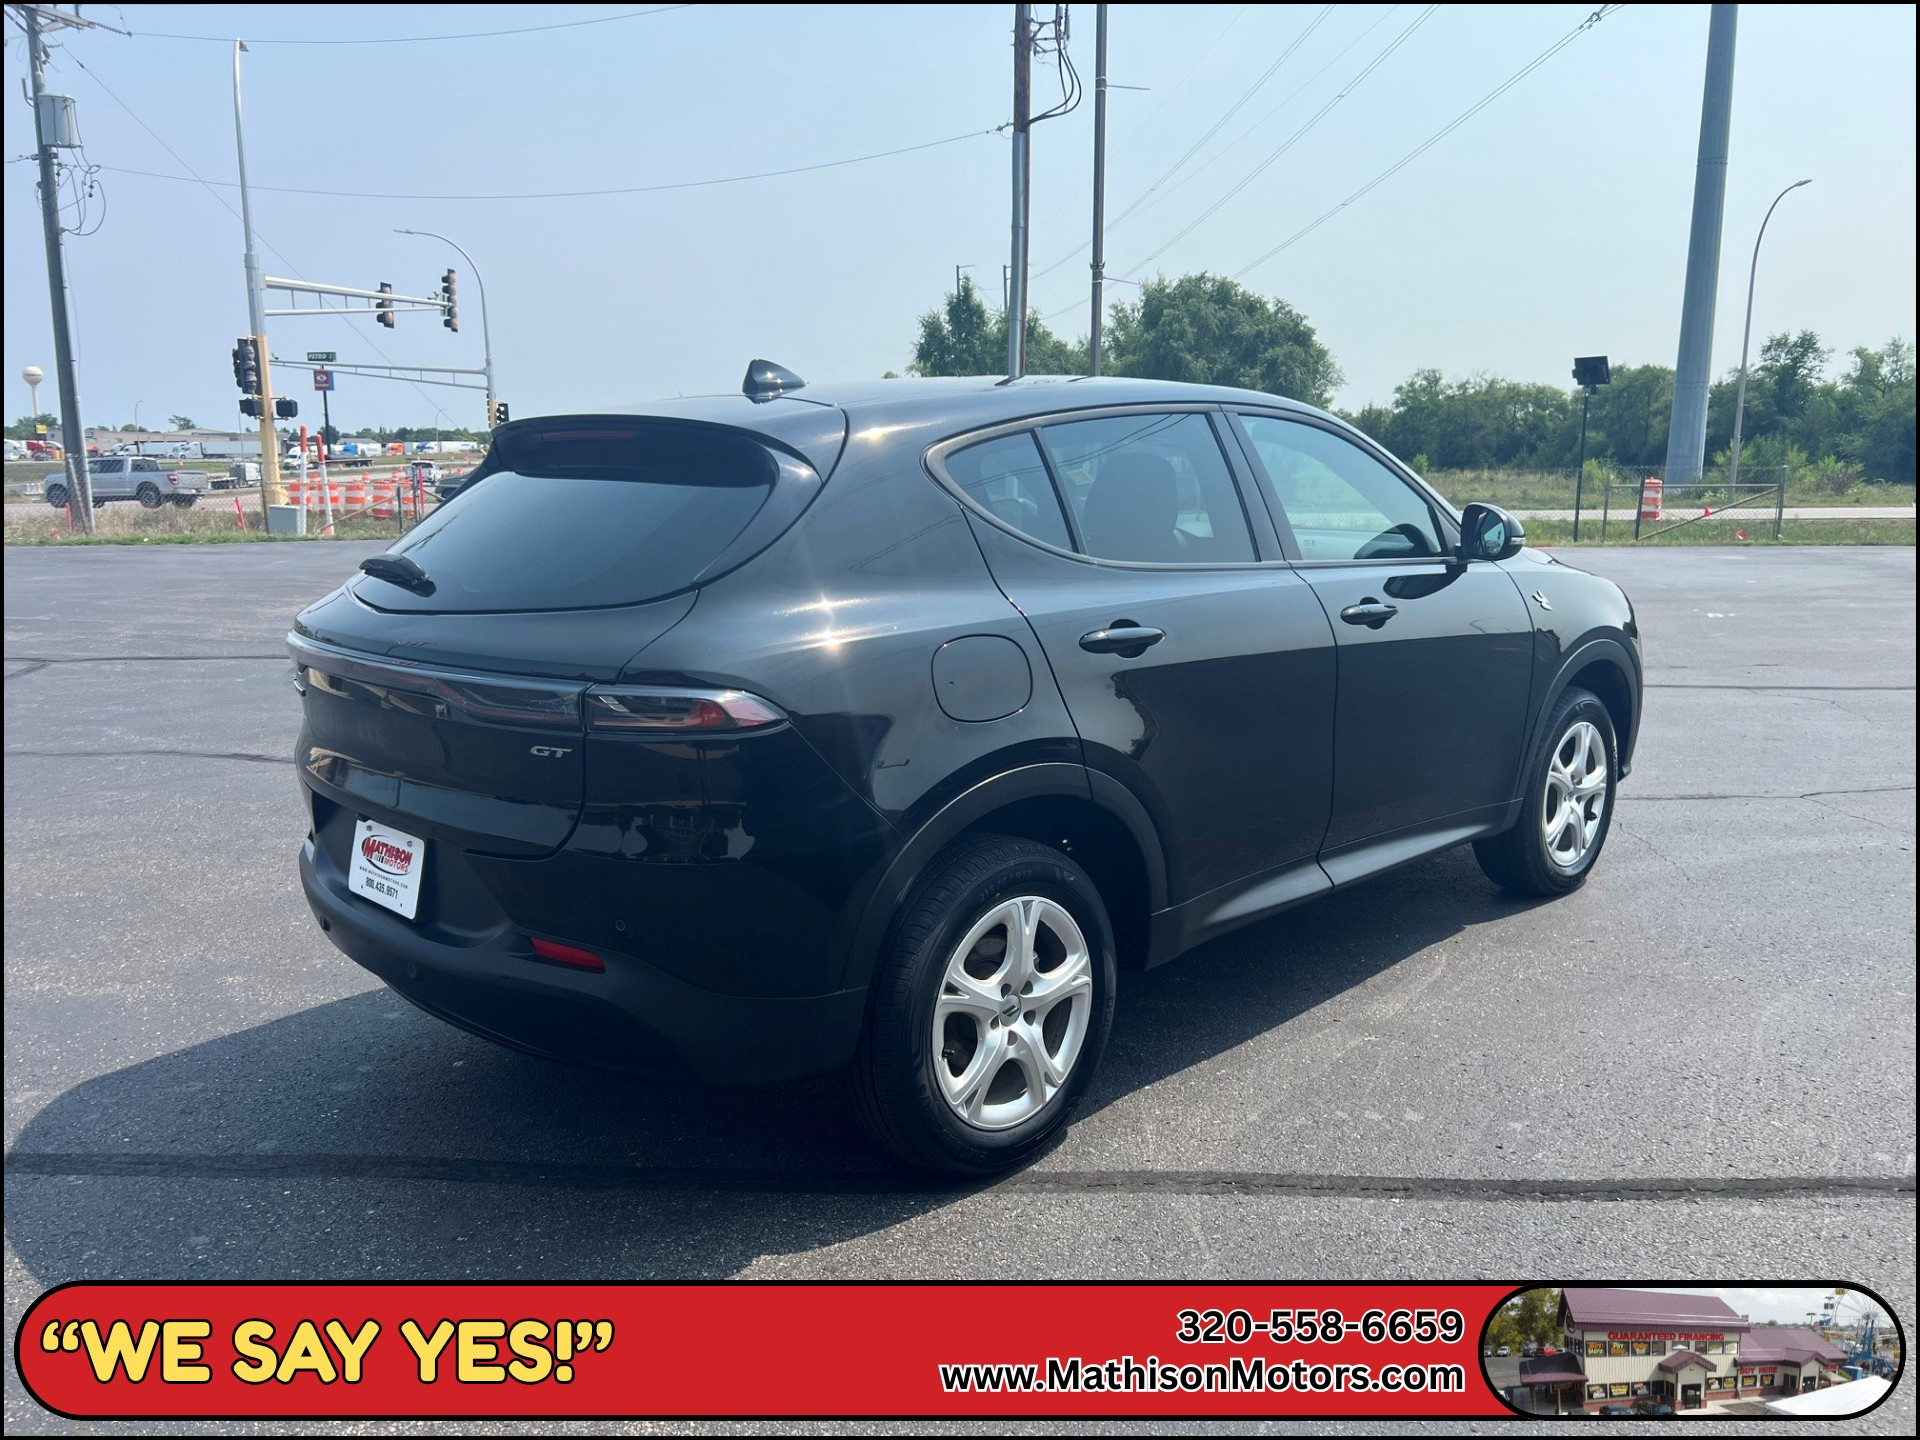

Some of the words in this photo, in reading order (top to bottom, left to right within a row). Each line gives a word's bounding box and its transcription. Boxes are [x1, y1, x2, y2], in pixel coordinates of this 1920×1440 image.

[530, 745, 573, 758] GT
[362, 836, 413, 866] MATHISON
[384, 857, 409, 873] MOTORS
[1607, 1331, 1677, 1341] GUARANTEED
[1678, 1333, 1725, 1341] FINANCING
[1739, 1367, 1756, 1375] BUY
[1759, 1366, 1778, 1375] HERE
